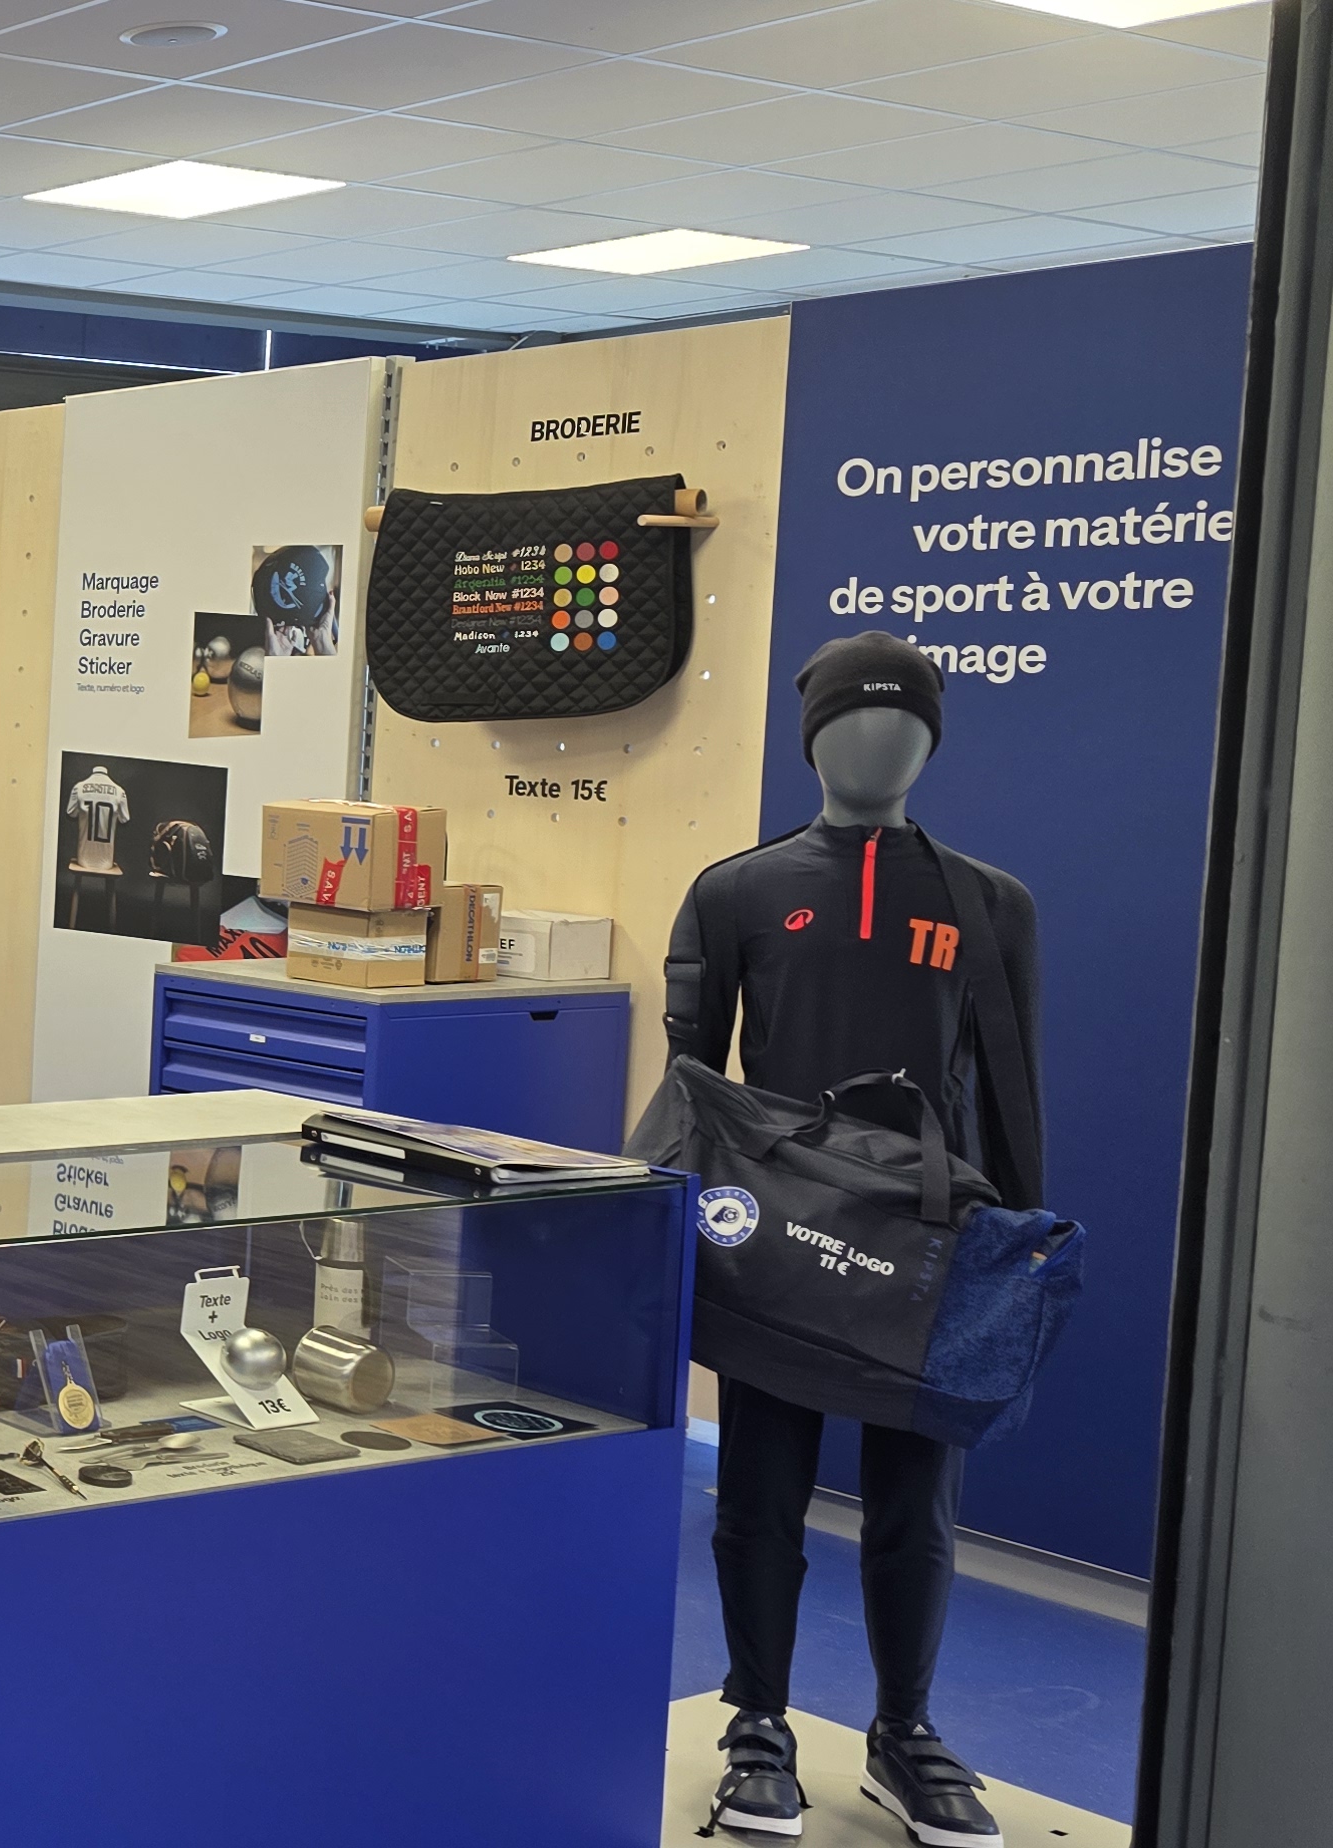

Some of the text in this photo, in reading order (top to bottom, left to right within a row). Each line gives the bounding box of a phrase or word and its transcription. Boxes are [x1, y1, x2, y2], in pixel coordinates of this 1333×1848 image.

[530, 411, 641, 442] BRODERIE
[836, 436, 1223, 502] On personnalise
[912, 500, 1235, 554] votre matérie
[454, 560, 546, 576] Hobo New 1234
[81, 572, 160, 594] Marquage
[511, 587, 544, 599] #1234
[829, 571, 1194, 623] de sport à votre
[80, 600, 145, 618] Broderie
[79, 628, 140, 646] Gravure
[475, 643, 511, 654] Avante
[77, 656, 132, 674] Sticker
[863, 682, 902, 692] KIPSTA
[504, 775, 608, 802] Texte 15€
[84, 800, 114, 843] 10
[465, 895, 476, 962] DECATHLON
[908, 918, 961, 971] TR
[786, 1221, 895, 1276] VOTRE LOGO
[199, 1294, 231, 1308] Texte
[258, 1398, 292, 1415] 13€
